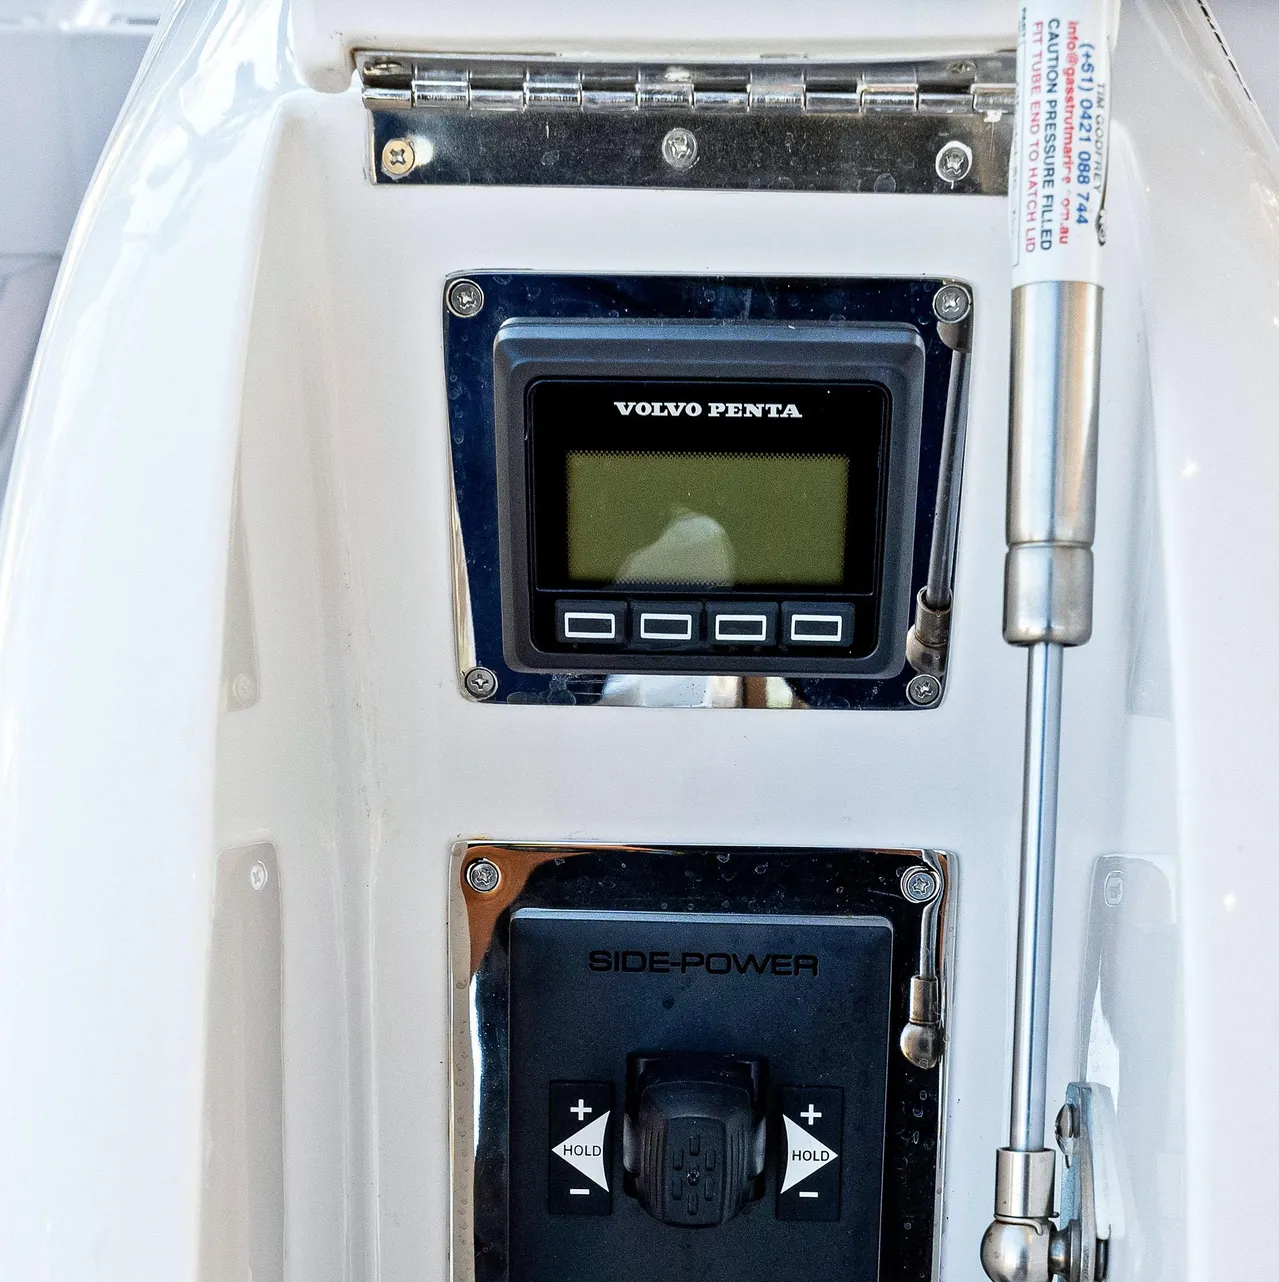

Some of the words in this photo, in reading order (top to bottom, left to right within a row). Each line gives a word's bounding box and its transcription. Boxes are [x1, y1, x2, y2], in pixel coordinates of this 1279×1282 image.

[1033, 21, 1043, 45] FIT
[1046, 18, 1060, 94] CAUTION
[1031, 51, 1042, 97] TUBE
[1096, 84, 1105, 109] TIM
[1029, 101, 1041, 135] END
[1079, 98, 1093, 142] 0421
[1028, 140, 1039, 162] TO
[1042, 99, 1057, 190] PRESSURE
[1077, 151, 1091, 185] 088
[1027, 168, 1038, 223] HATCH
[1075, 192, 1090, 225] 744
[1040, 194, 1054, 251] FILLED
[1025, 228, 1036, 253] LID
[613, 401, 702, 418] VOLVO
[707, 401, 803, 419] PENTA
[588, 950, 819, 977] SIDE-POWER
[562, 1143, 602, 1157] HOLD
[791, 1148, 831, 1163] HOLD
